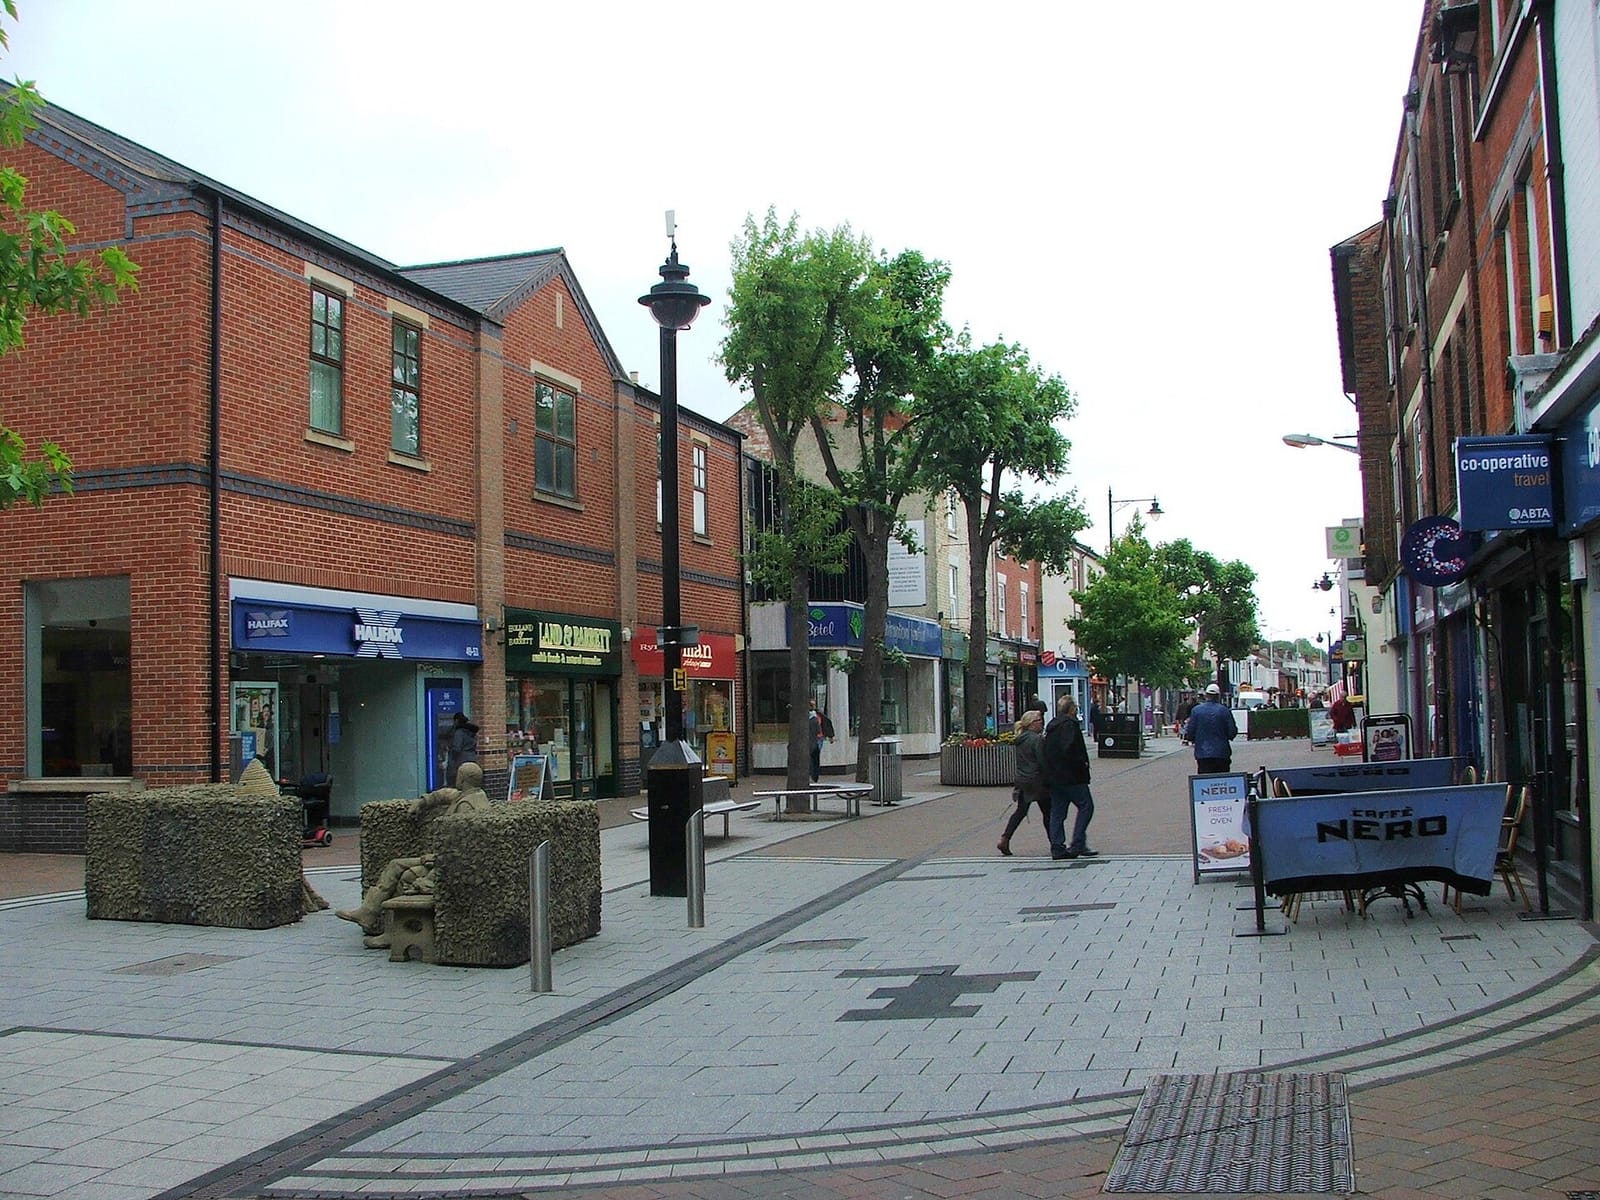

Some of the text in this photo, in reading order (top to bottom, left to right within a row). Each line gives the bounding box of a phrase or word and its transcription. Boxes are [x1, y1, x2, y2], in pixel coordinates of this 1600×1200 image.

[1514, 471, 1550, 487] travel
[1520, 508, 1551, 519] ABTA
[248, 619, 288, 629] HALIFAX
[508, 624, 534, 632] HOLLAND
[355, 624, 404, 643] HALIFAX
[509, 638, 534, 646] BARRETT
[573, 626, 612, 653] BARRETT
[1201, 786, 1237, 796] NERO
[1210, 817, 1232, 825] OVEN
[1316, 815, 1447, 843] NERO
